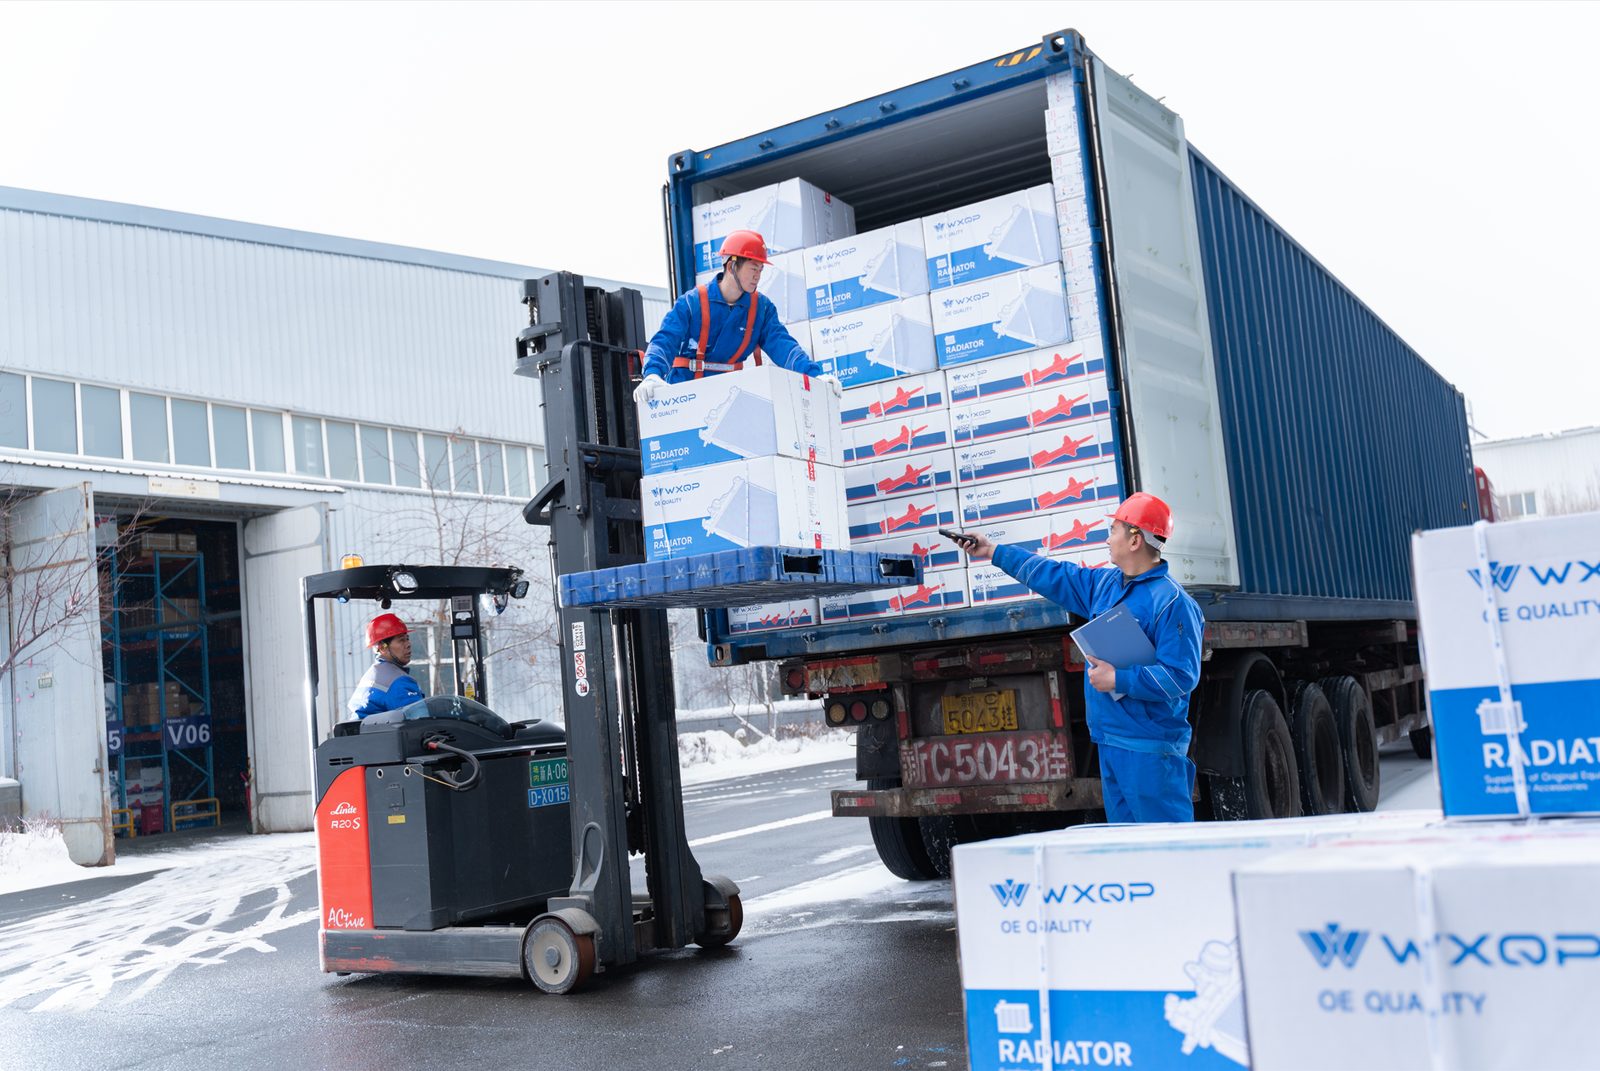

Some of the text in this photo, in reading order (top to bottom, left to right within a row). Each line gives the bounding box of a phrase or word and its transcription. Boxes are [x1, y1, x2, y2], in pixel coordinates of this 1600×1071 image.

[955, 291, 990, 305] WXQP
[945, 339, 985, 354] RADIATOR
[661, 393, 697, 407] WXQP
[658, 409, 678, 418] QUALITY
[650, 446, 690, 461] RADIATOR
[665, 482, 700, 495] WXQP
[168, 723, 210, 745] V06
[330, 801, 357, 816] Linde
[1043, 882, 1155, 905] WXQP
[1000, 920, 1022, 934] OE
[1380, 932, 1600, 967] WXQP
[1318, 990, 1487, 1015] OE QUAITY
